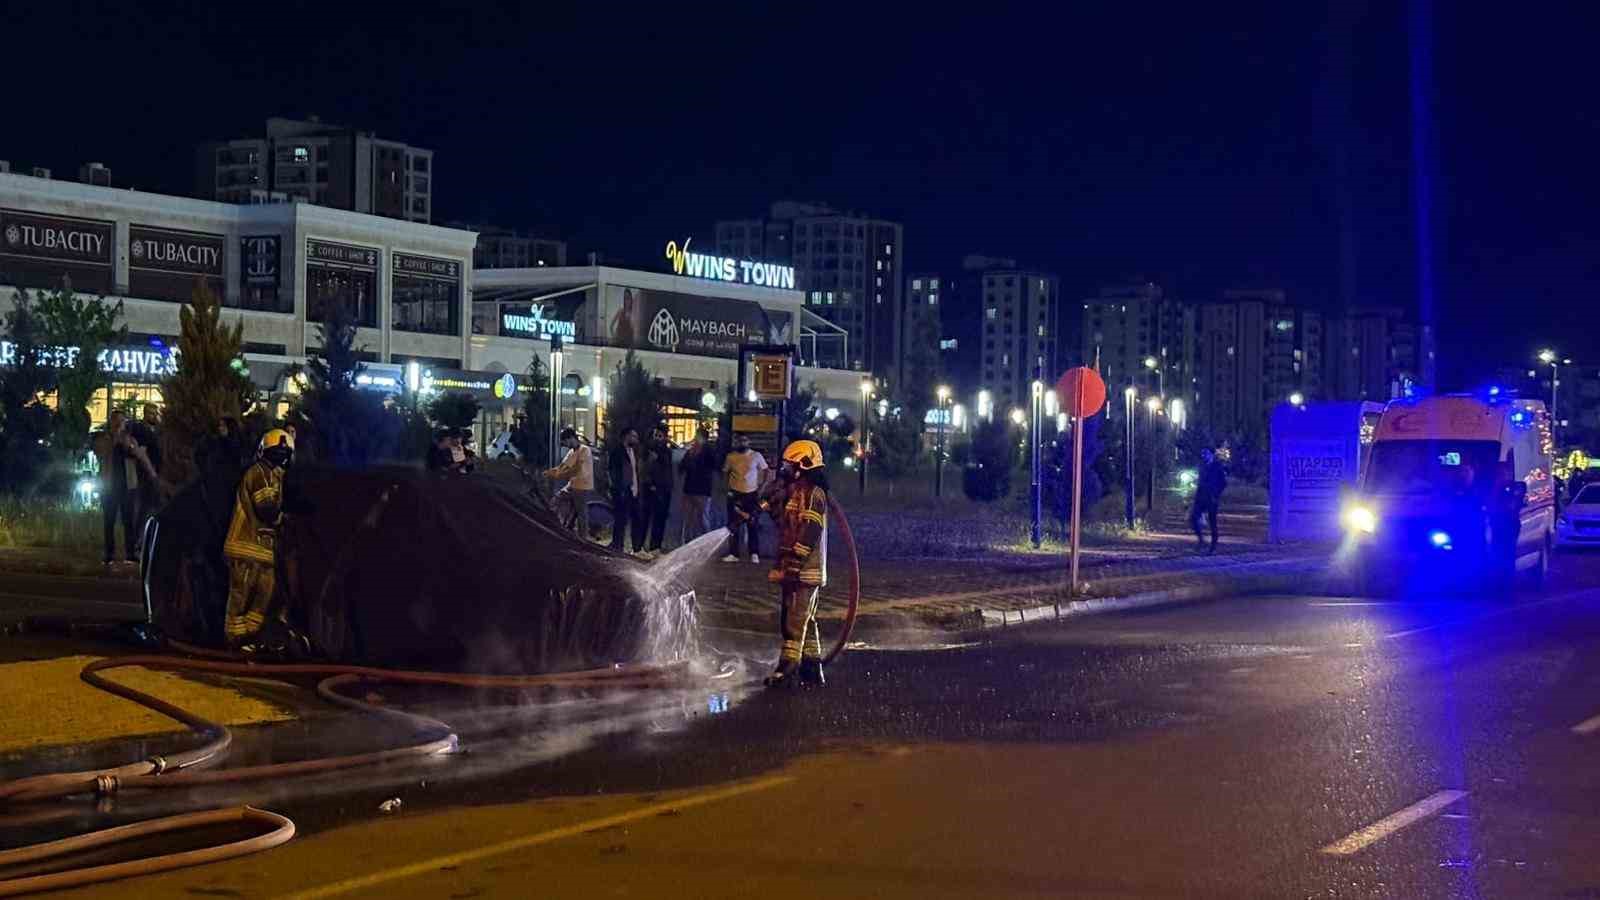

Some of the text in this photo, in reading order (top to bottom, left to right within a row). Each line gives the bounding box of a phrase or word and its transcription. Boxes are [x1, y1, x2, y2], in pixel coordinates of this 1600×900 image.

[20, 225, 104, 254] TUBACITY
[144, 240, 220, 267] TUBACITY
[685, 252, 736, 281] WINS
[740, 260, 795, 289] TOWN
[503, 314, 576, 336] WINS TOWN
[680, 318, 745, 337] MAYBACH
